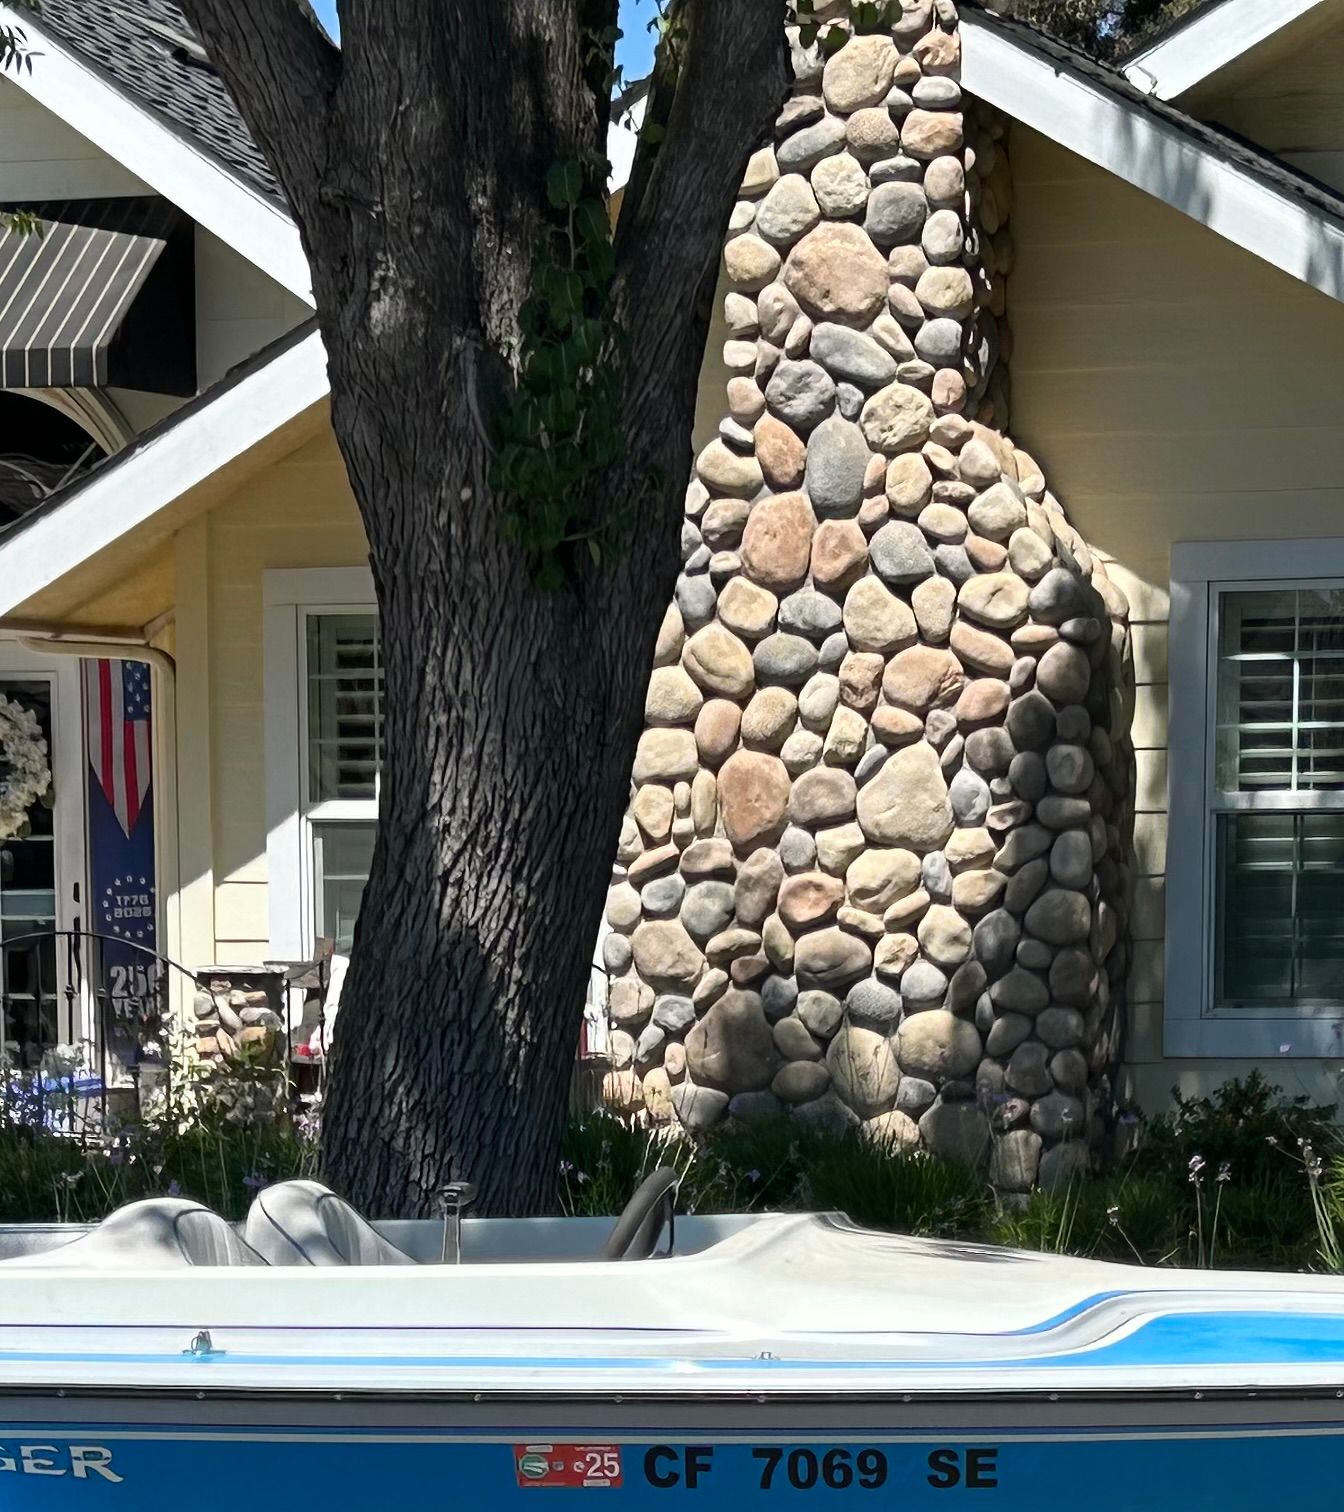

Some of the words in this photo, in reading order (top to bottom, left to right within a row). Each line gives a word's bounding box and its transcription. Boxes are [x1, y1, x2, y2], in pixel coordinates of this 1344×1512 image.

[585, 1453, 620, 1477] 25
[643, 1447, 713, 1489] CF
[752, 1448, 888, 1489] 7069
[926, 1449, 998, 1489] SE
